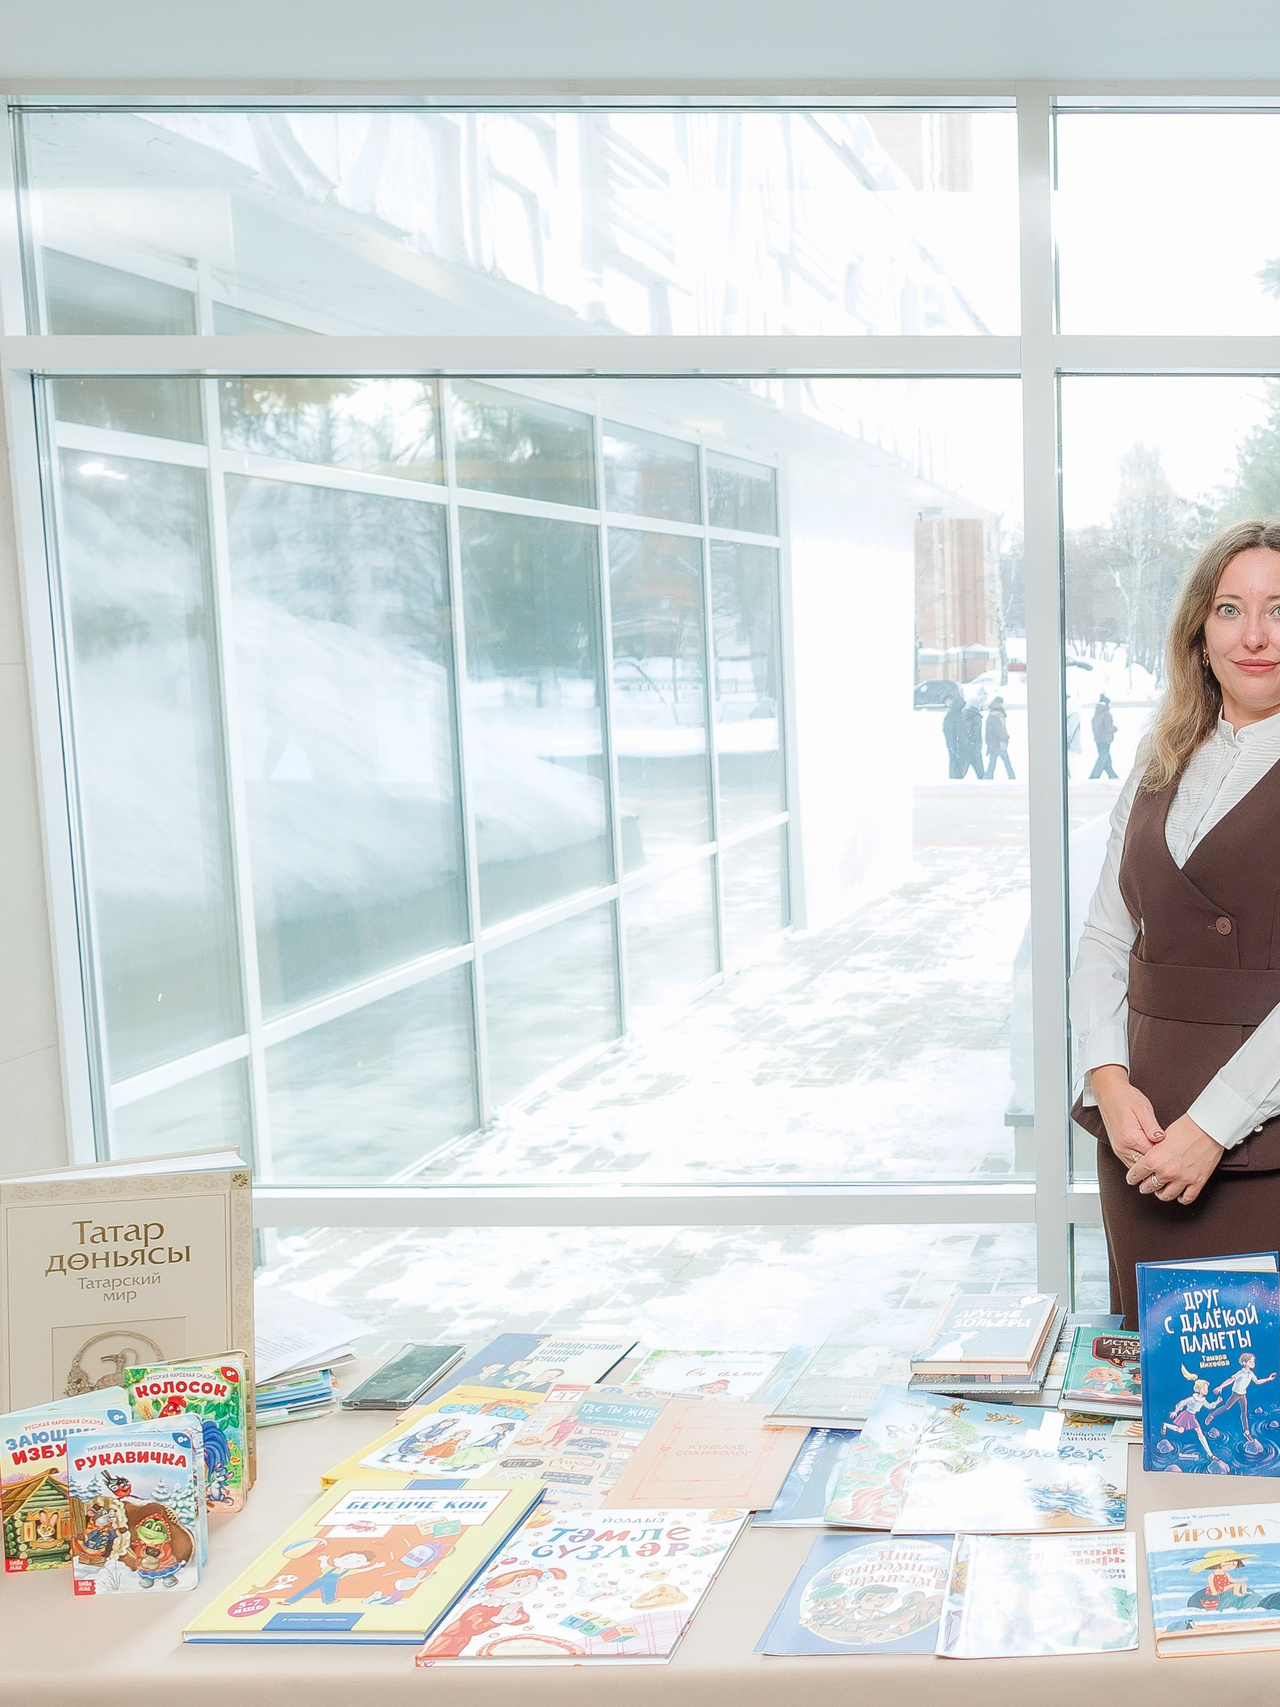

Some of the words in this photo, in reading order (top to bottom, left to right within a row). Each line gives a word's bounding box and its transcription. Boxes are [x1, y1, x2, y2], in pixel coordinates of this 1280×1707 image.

[71, 1220, 165, 1247] Татар
[44, 1245, 192, 1277] дөньясы
[77, 1272, 162, 1290] Татарский
[102, 1291, 138, 1303] мир
[1183, 1288, 1220, 1311] ДРУГ
[954, 1308, 1023, 1319] ДРУГИЕ
[1164, 1316, 1175, 1334] С
[1181, 1302, 1260, 1333] ДАЛЁКОЙ
[952, 1318, 1032, 1329] ВОЛЬЕРЫ
[1103, 1339, 1140, 1347] ИСТО
[1180, 1329, 1253, 1355] ПЛАНЕТЫ
[1201, 1354, 1227, 1362] Тамара
[1200, 1360, 1230, 1369] Михеева
[146, 1373, 169, 1381] РУССКАЯ
[197, 1373, 217, 1381] СКАЗКА
[226, 1369, 237, 1378] 0+
[135, 1380, 228, 1399] КОЛОСОК
[485, 1406, 530, 1421] КЫ
[581, 1403, 602, 1413] ГДЕ
[608, 1405, 622, 1414] ТЫ
[113, 1413, 124, 1421] 0+
[24, 1420, 50, 1431] РУССКАЯ
[51, 1419, 80, 1427] НАРОДНАЯ
[81, 1418, 104, 1426] СКАЗКА
[177, 1436, 189, 1444] 0+
[87, 1442, 122, 1453] УКРАИНСКАЯ
[152, 1442, 175, 1450] СКАЗКА
[12, 1443, 67, 1466] ИЗБУ
[74, 1451, 187, 1471] РУКАВИЧКА
[346, 1500, 439, 1509] БЕРЕНЧЕ
[603, 1516, 665, 1524] ЙОЛДЫЗ
[547, 1526, 691, 1543] ТӘМЛЕ
[1173, 1524, 1266, 1543] ИРОЧКА
[532, 1543, 690, 1560] СҮЗЛӘР
[846, 1574, 931, 1587] яратам
[238, 1598, 262, 1609] 5-7
